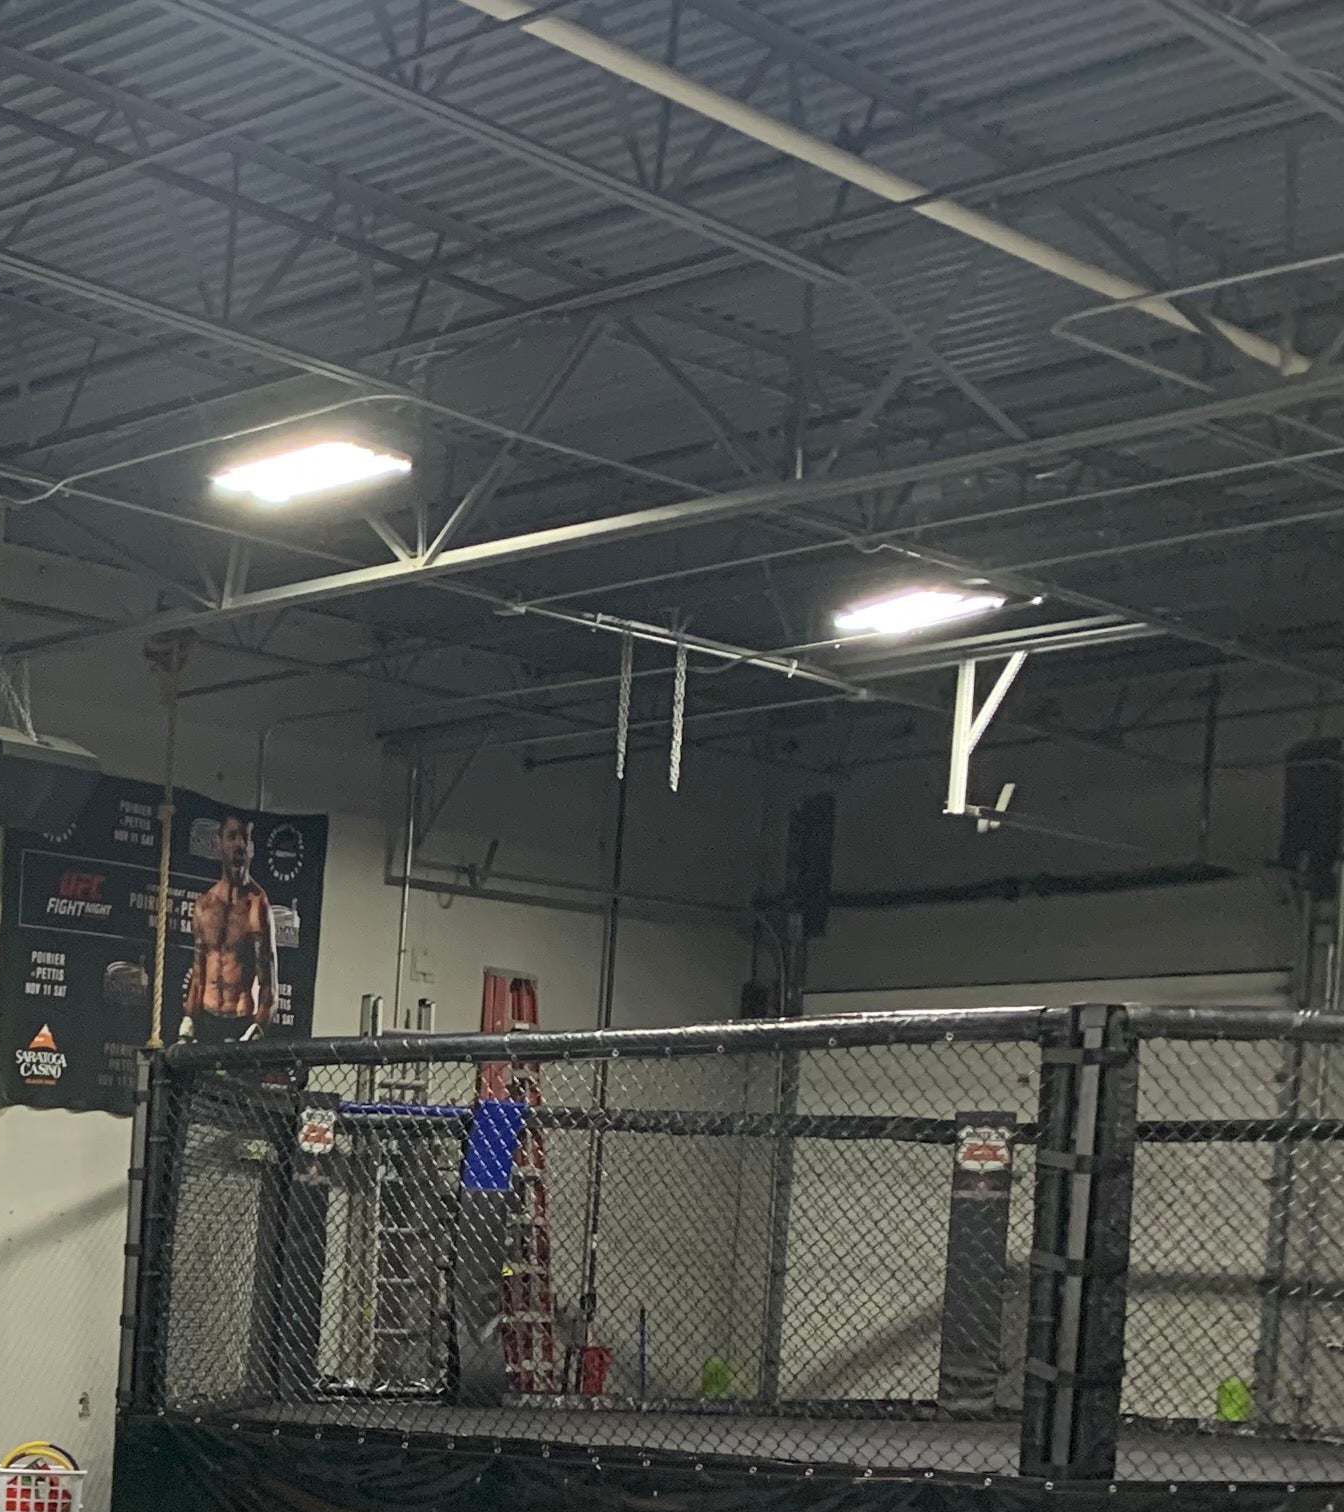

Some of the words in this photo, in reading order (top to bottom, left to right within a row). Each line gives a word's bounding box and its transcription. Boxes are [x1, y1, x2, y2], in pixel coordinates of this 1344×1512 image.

[46, 897, 86, 917] FIGHT
[180, 919, 192, 934] SA
[31, 951, 66, 966] POIRIER
[24, 982, 40, 995] NOV
[53, 984, 68, 998] SAT
[15, 1049, 68, 1068] SARATOGA
[19, 1063, 62, 1079] CASINO
